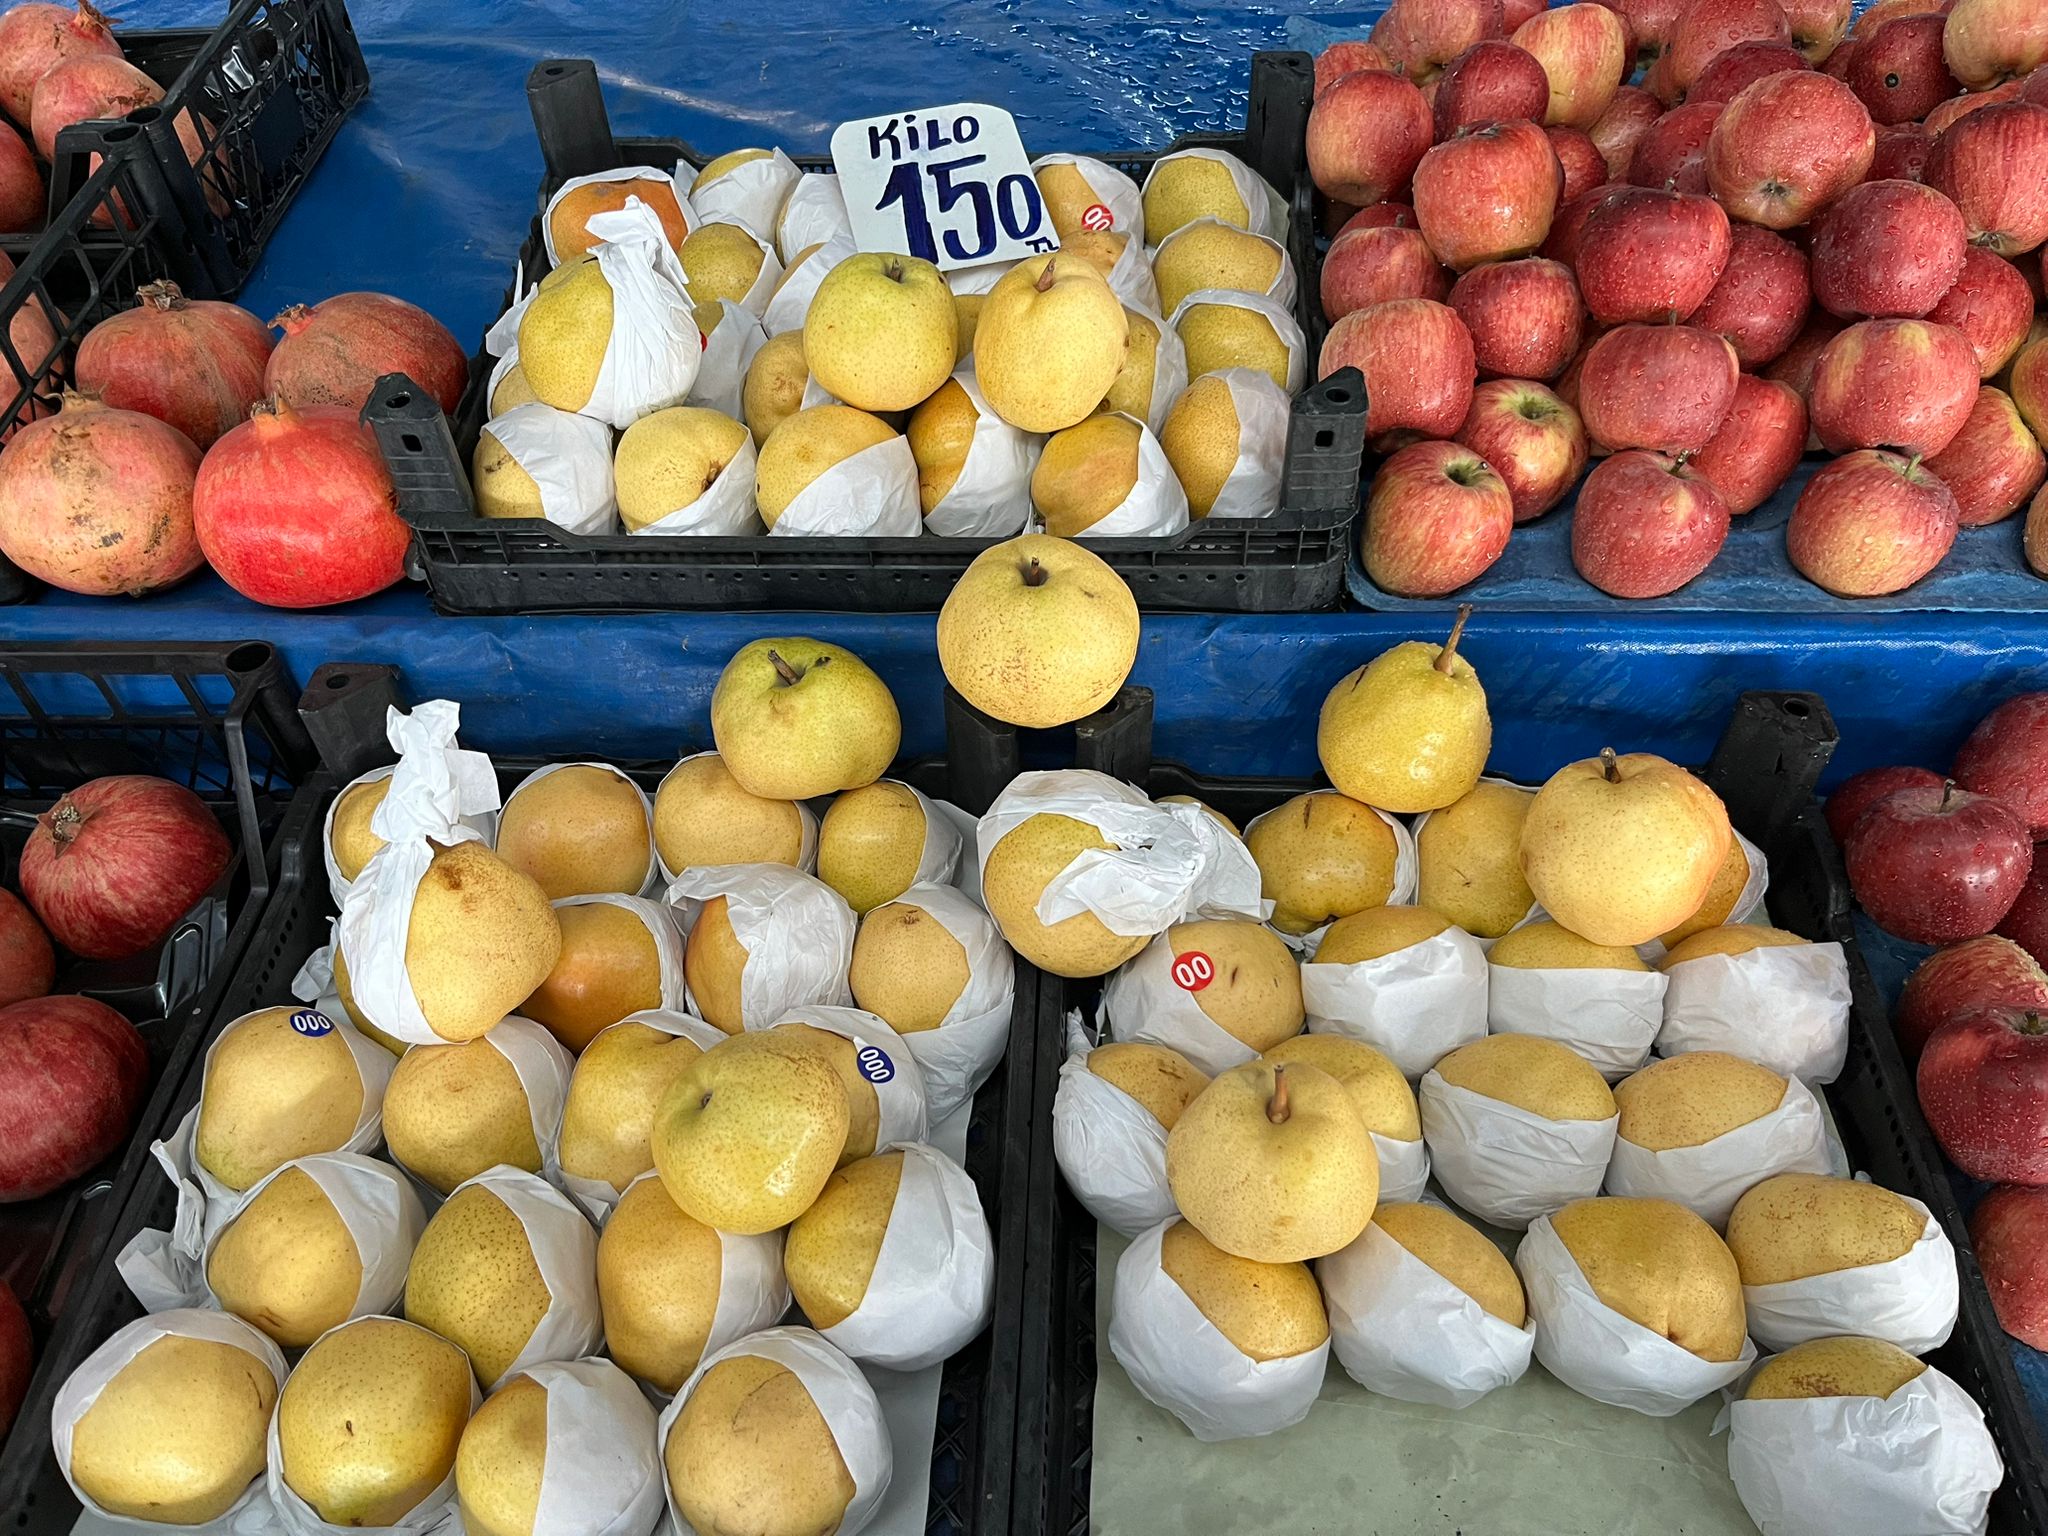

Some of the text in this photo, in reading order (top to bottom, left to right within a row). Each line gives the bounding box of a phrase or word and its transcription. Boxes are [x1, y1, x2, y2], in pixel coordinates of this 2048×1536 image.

[875, 155, 1041, 264] 150
[1176, 956, 1210, 987] 00
[294, 1015, 330, 1031] 000
[860, 1049, 890, 1080] 000
